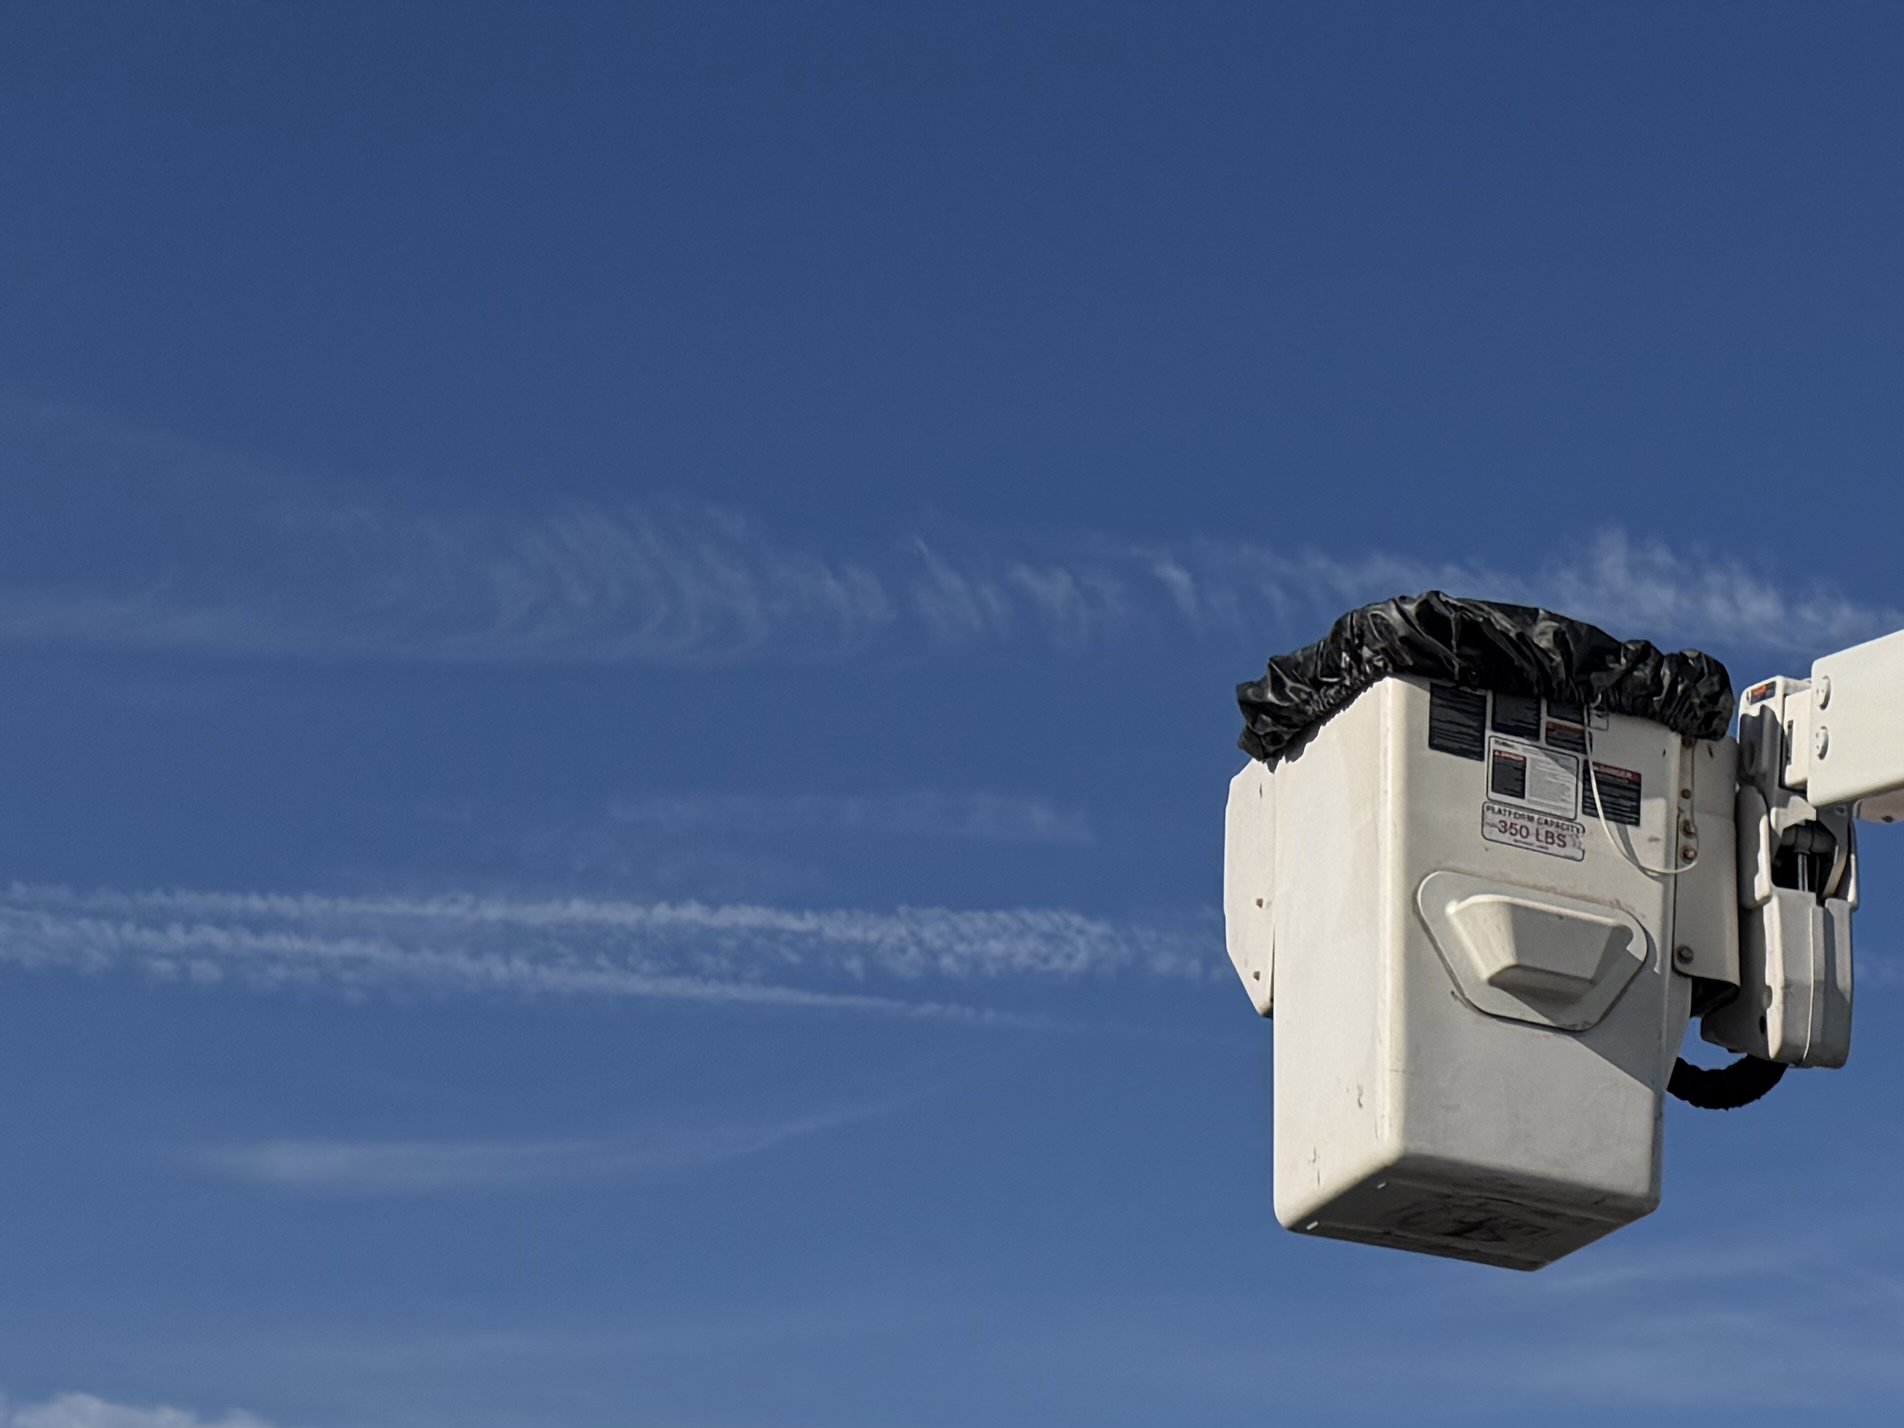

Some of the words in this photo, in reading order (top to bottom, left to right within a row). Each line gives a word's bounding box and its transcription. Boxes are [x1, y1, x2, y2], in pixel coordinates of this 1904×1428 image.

[1486, 805, 1535, 823] PLATFORM
[1498, 820, 1530, 840] 350
[1535, 827, 1567, 849] LBS
